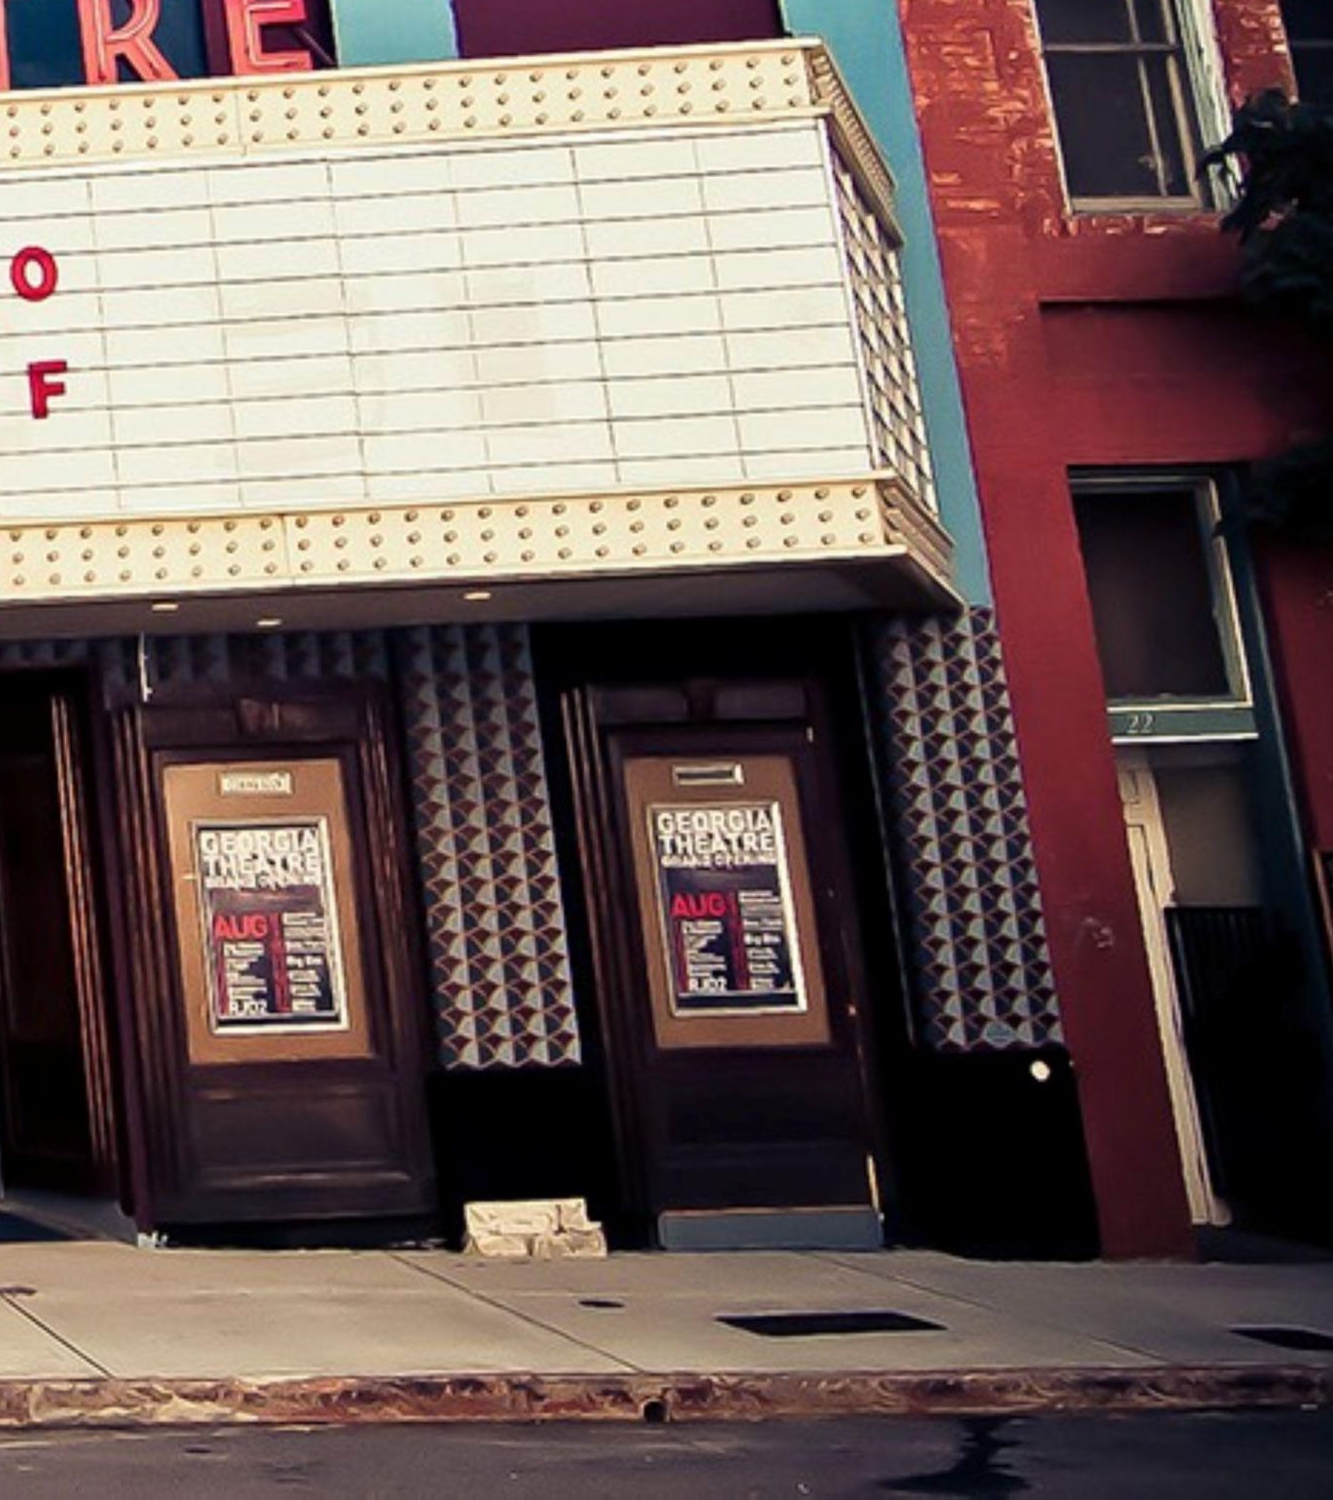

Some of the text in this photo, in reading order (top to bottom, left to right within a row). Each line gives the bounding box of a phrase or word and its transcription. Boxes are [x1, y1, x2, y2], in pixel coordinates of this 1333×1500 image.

[1126, 711, 1154, 735] 22
[657, 810, 771, 833] GEORGIA
[200, 829, 318, 853] GEORGIA
[658, 832, 775, 854] THEATRE
[203, 852, 320, 877] THEATRE
[671, 892, 726, 917] AUG
[214, 914, 267, 939] AUG
